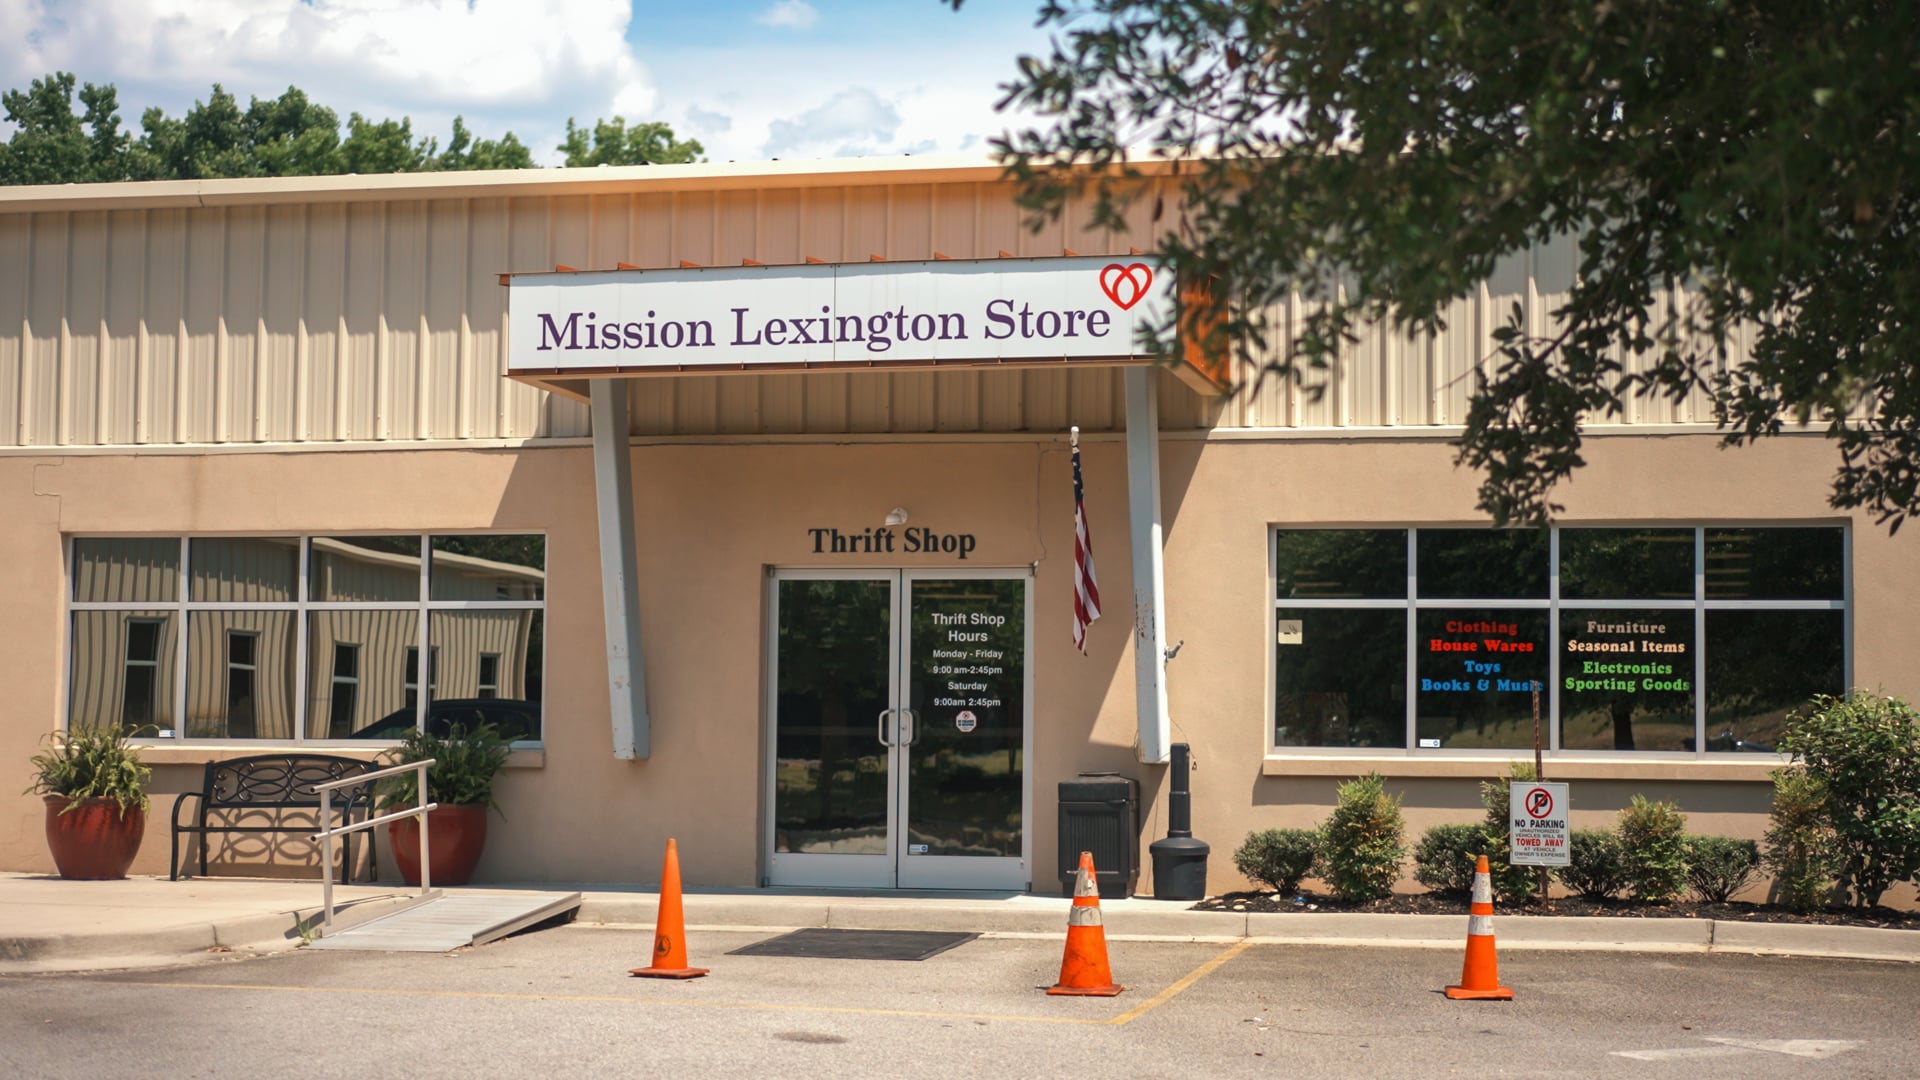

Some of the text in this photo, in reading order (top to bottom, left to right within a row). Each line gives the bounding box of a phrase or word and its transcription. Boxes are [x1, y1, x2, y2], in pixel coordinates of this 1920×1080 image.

[536, 298, 1112, 352] Mission Lexington Store
[808, 527, 976, 559] Thrift Shop
[931, 612, 1006, 627] Thrift Shop
[1445, 621, 1518, 636] Clothing
[1586, 621, 1667, 634] Furniture
[948, 630, 989, 642] Hours
[1430, 639, 1534, 652] House Wares
[1567, 639, 1686, 653] Seasonal Items
[932, 649, 968, 660] Monday
[975, 649, 1004, 660] Friday
[932, 665, 1003, 676] 9:00 am-2:45pm
[1464, 660, 1501, 674] Toys
[1582, 661, 1673, 674] Electronics
[947, 681, 988, 692] Saturday
[1421, 679, 1471, 692] Books
[1477, 680, 1490, 691] &
[1565, 677, 1691, 693] Sporting Goods
[933, 698, 1001, 708] 9:00am 2:45pm
[1514, 819, 1565, 829] NO PARKING
[1516, 838, 1564, 847] TOWED AWAY
